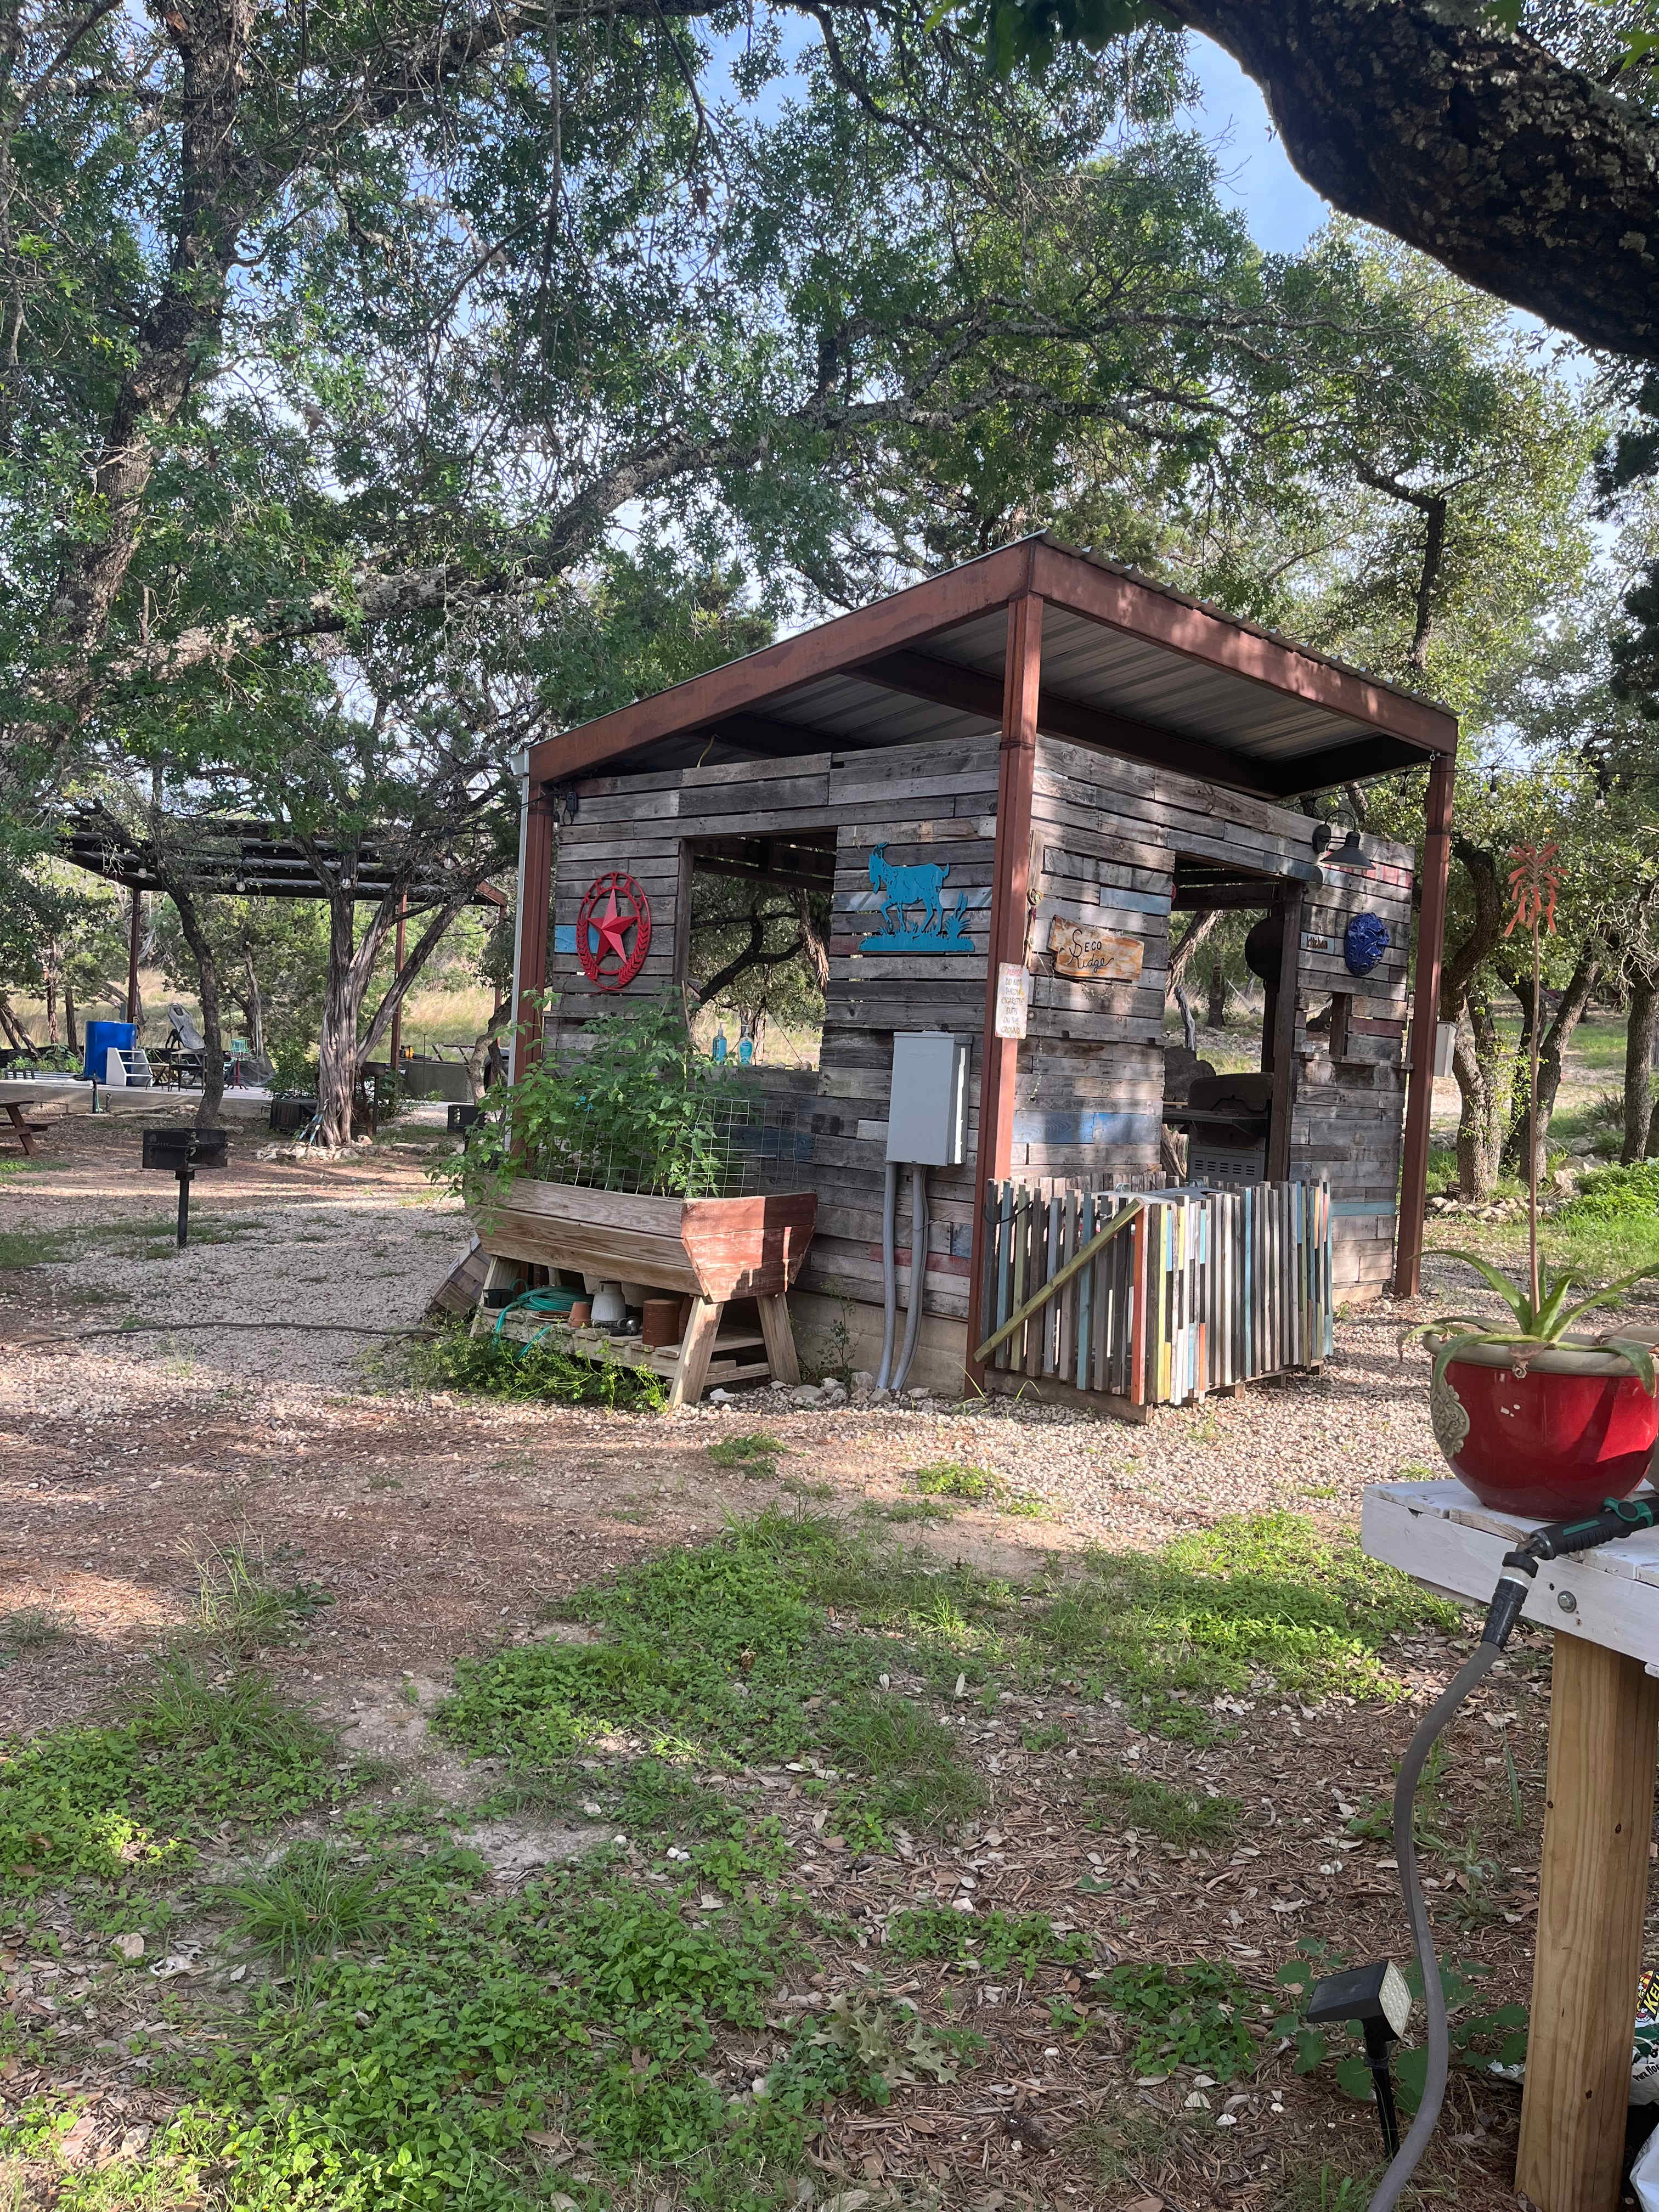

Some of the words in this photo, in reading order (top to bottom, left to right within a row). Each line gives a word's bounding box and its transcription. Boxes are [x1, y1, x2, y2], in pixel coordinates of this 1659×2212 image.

[1306, 935, 1328, 950] kitchen
[1007, 968, 1023, 976] PLEASE
[1005, 977, 1012, 985] DO
[1013, 978, 1022, 986] NOT
[1005, 987, 1021, 996] THROW
[1001, 996, 1024, 1006] CIGARETTE
[1011, 1017, 1019, 1025] THE
[1001, 1026, 1020, 1035] GROUND
